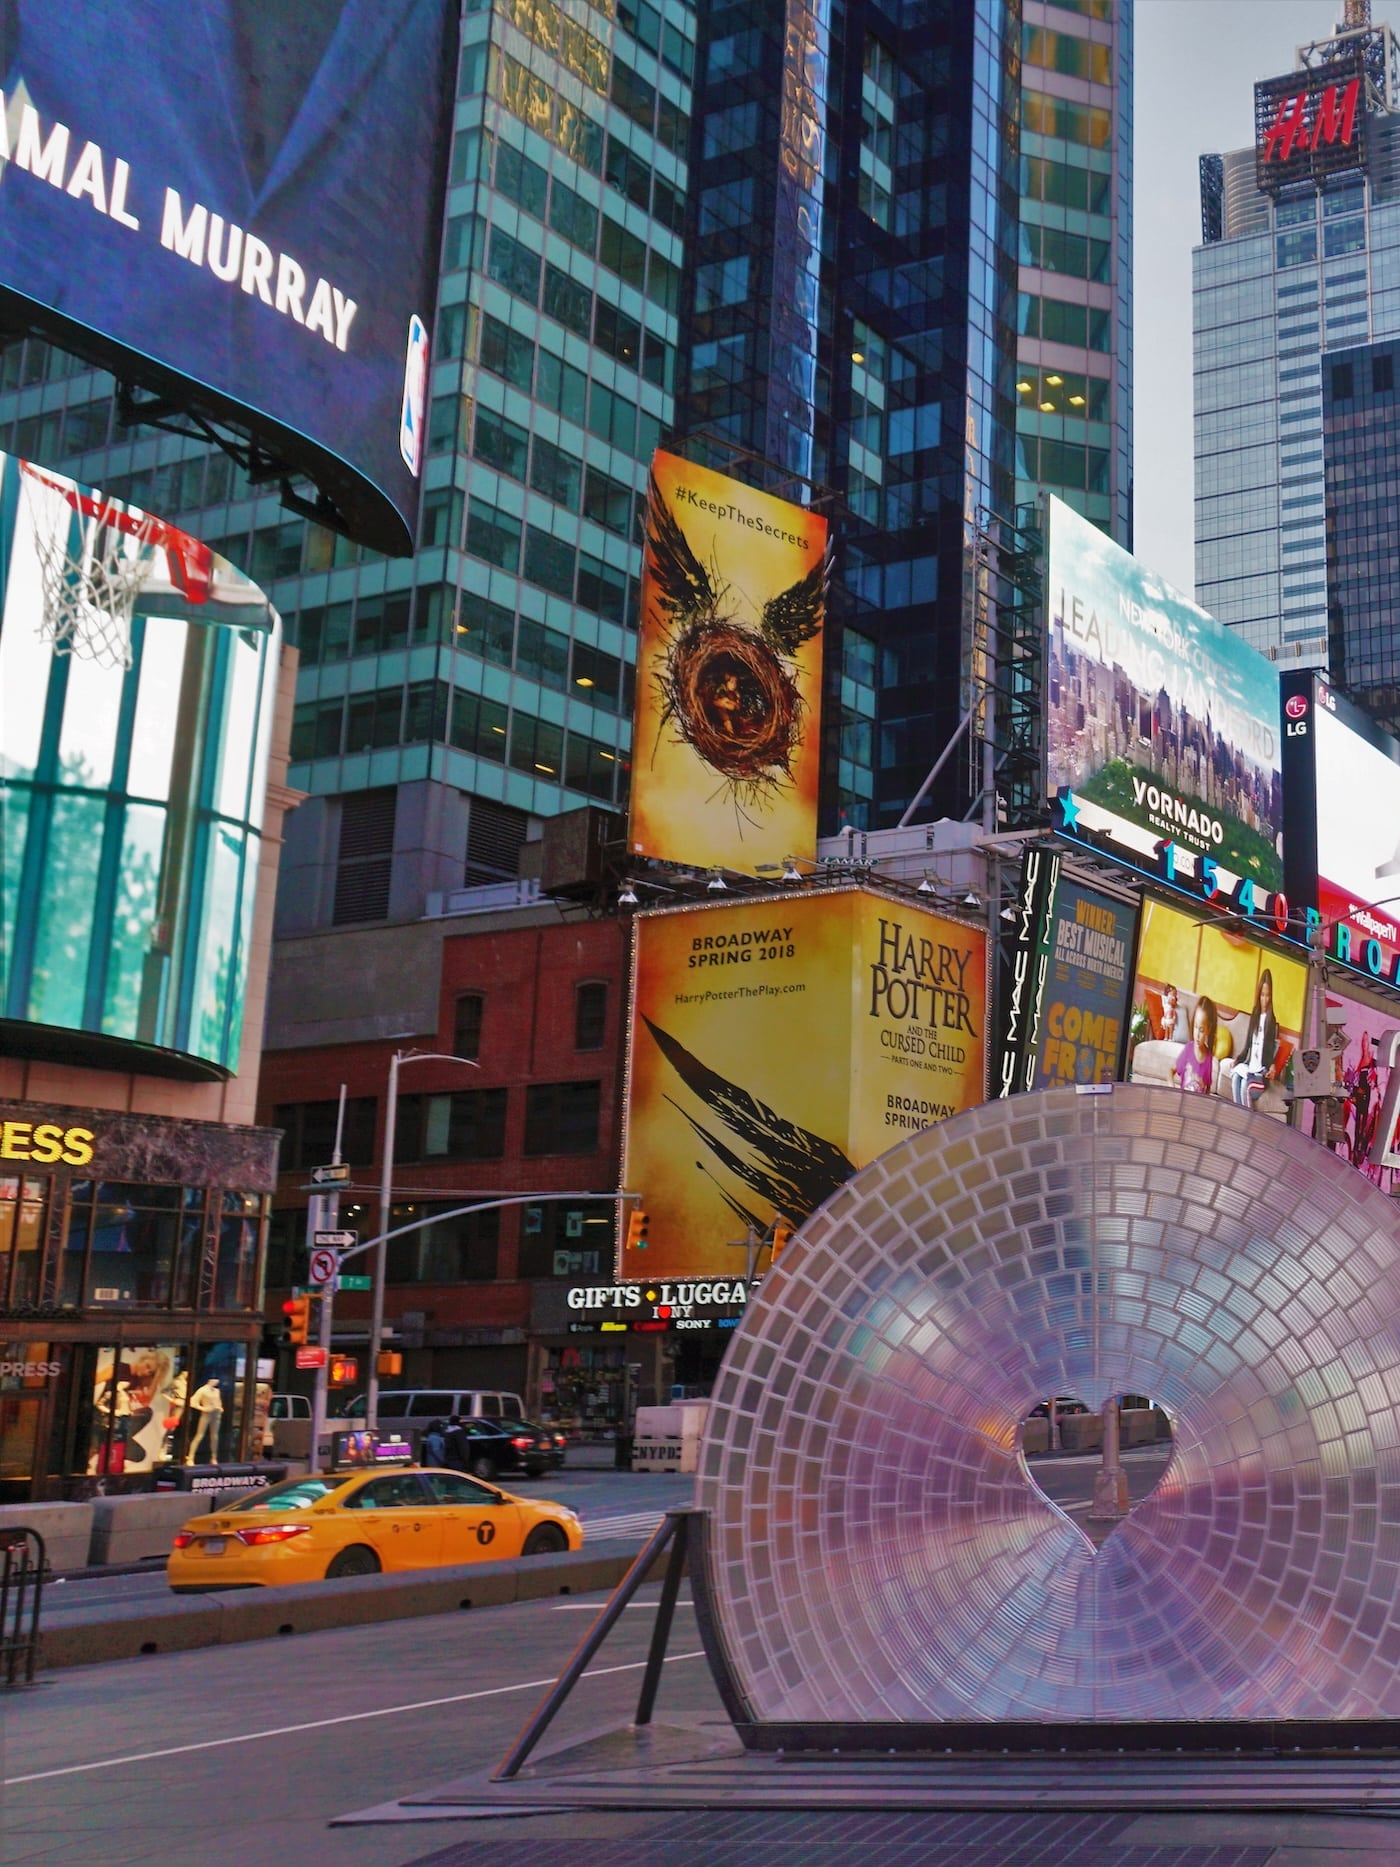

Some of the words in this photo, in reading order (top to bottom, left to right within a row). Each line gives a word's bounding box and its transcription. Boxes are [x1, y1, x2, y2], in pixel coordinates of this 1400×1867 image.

[1263, 78, 1361, 162] H&M
[160, 187, 358, 352] MURRAY
[674, 484, 810, 551] #KeepTheSecrets
[1286, 722, 1307, 736] LG
[1132, 776, 1224, 845] VORNADO
[1148, 813, 1182, 840] REALTY
[1183, 829, 1211, 852] TRUST
[824, 856, 874, 866] LAMAR
[1076, 899, 1117, 936] WINNER!
[692, 927, 794, 952] BROADWAY
[1057, 918, 1082, 950] BEST
[1085, 928, 1125, 968] MUSICAL
[688, 949, 752, 969] SPRING
[759, 944, 796, 961] 2018
[877, 919, 973, 992] HARRY
[1055, 946, 1065, 962] ALL
[1066, 951, 1087, 969] ACROSS
[674, 981, 806, 1005] HarryPotterThePlay.com
[868, 964, 978, 1038] POTTER
[907, 1025, 923, 1037] AND
[924, 1029, 938, 1040] THE
[1047, 1002, 1119, 1050] COME
[880, 1030, 926, 1055] CURSED
[929, 1041, 966, 1064] CHILD
[891, 1055, 909, 1066] PARTS
[909, 1059, 922, 1069] ONE
[923, 1063, 937, 1072] AND
[938, 1066, 953, 1075] TWO
[887, 1094, 956, 1117] BROADWAY
[885, 1112, 929, 1131] SPRING
[0, 1122, 95, 1166] ESS
[567, 1286, 641, 1309] GIFTS
[659, 1281, 761, 1306] LUGGA
[670, 1305, 694, 1318] NY
[676, 1319, 711, 1329] SONY
[639, 1446, 680, 1460] NYPD
[191, 1475, 268, 1490] BROADWAY'S
